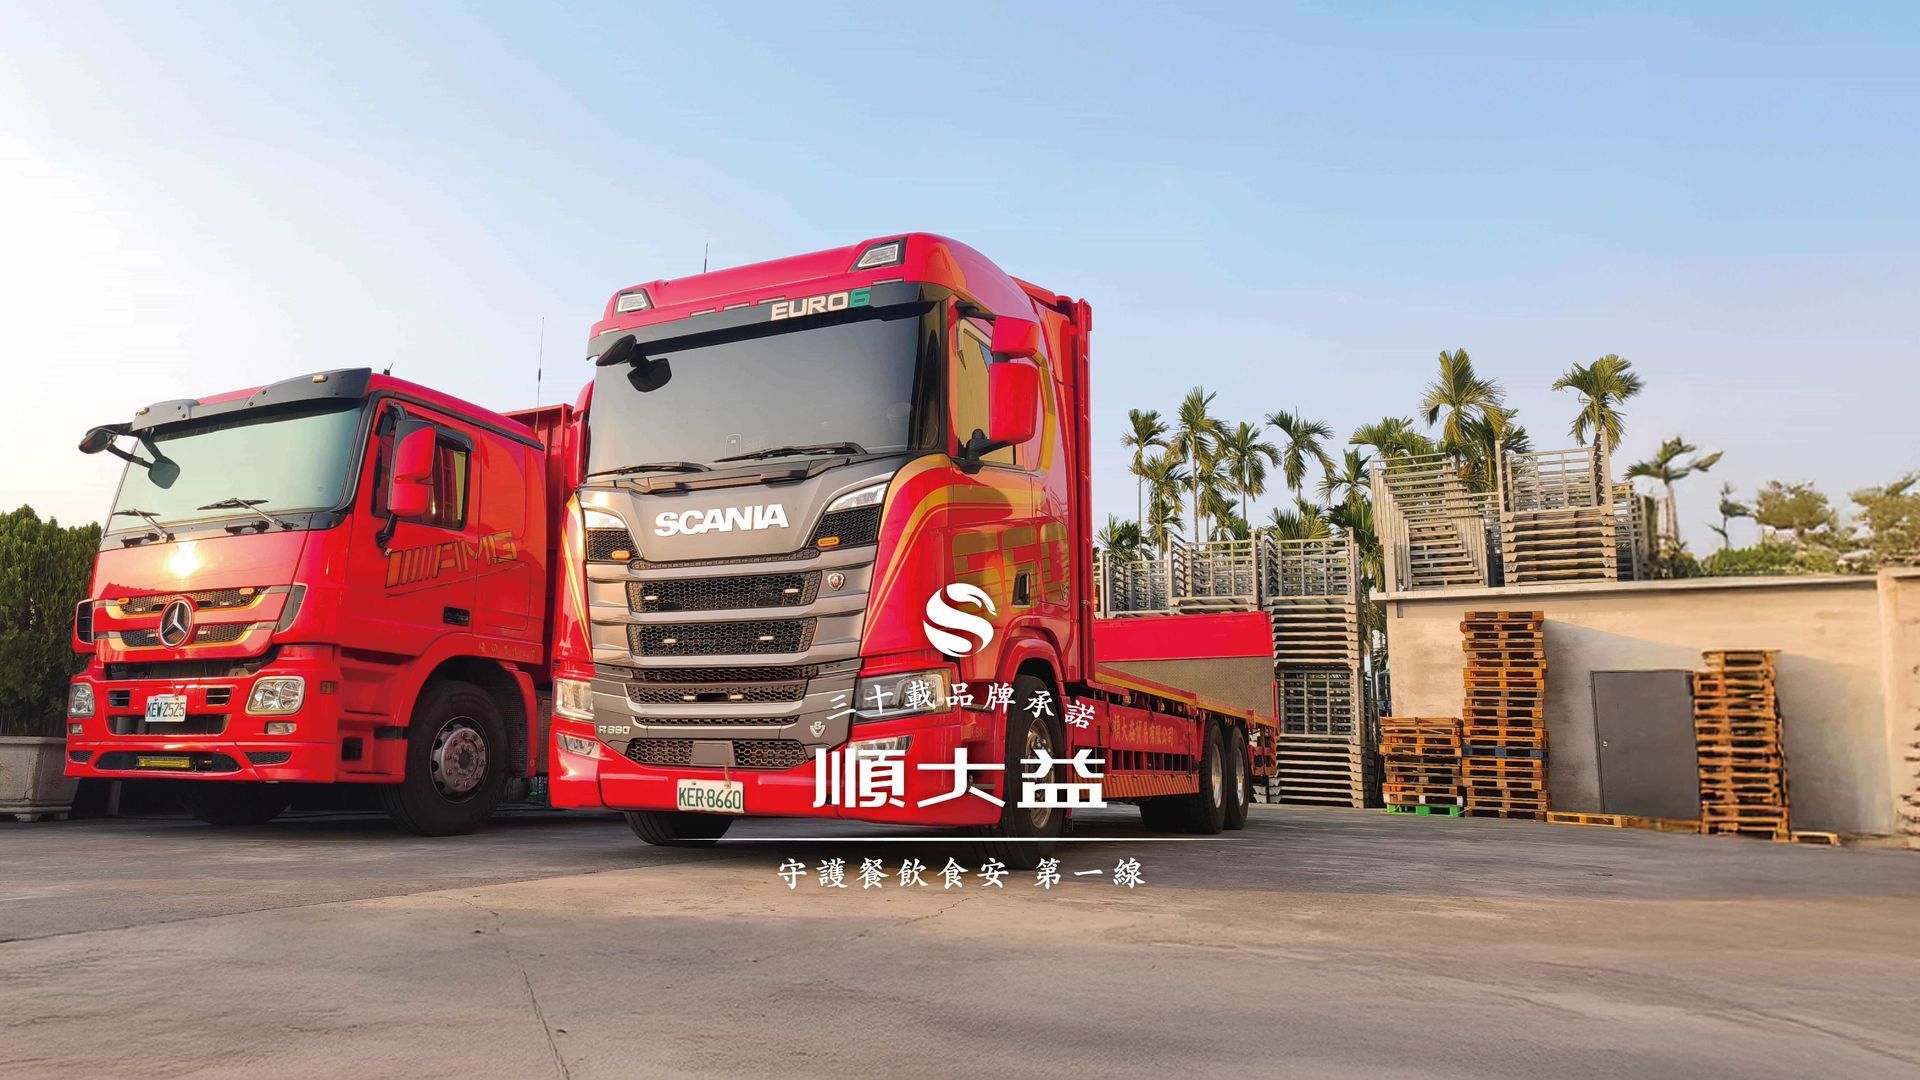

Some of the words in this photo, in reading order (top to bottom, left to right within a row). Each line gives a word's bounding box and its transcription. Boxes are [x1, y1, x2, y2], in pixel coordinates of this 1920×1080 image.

[654, 504, 789, 537] SCANIA
[146, 702, 185, 717] KEW-2525
[679, 787, 741, 809] KER-8660
